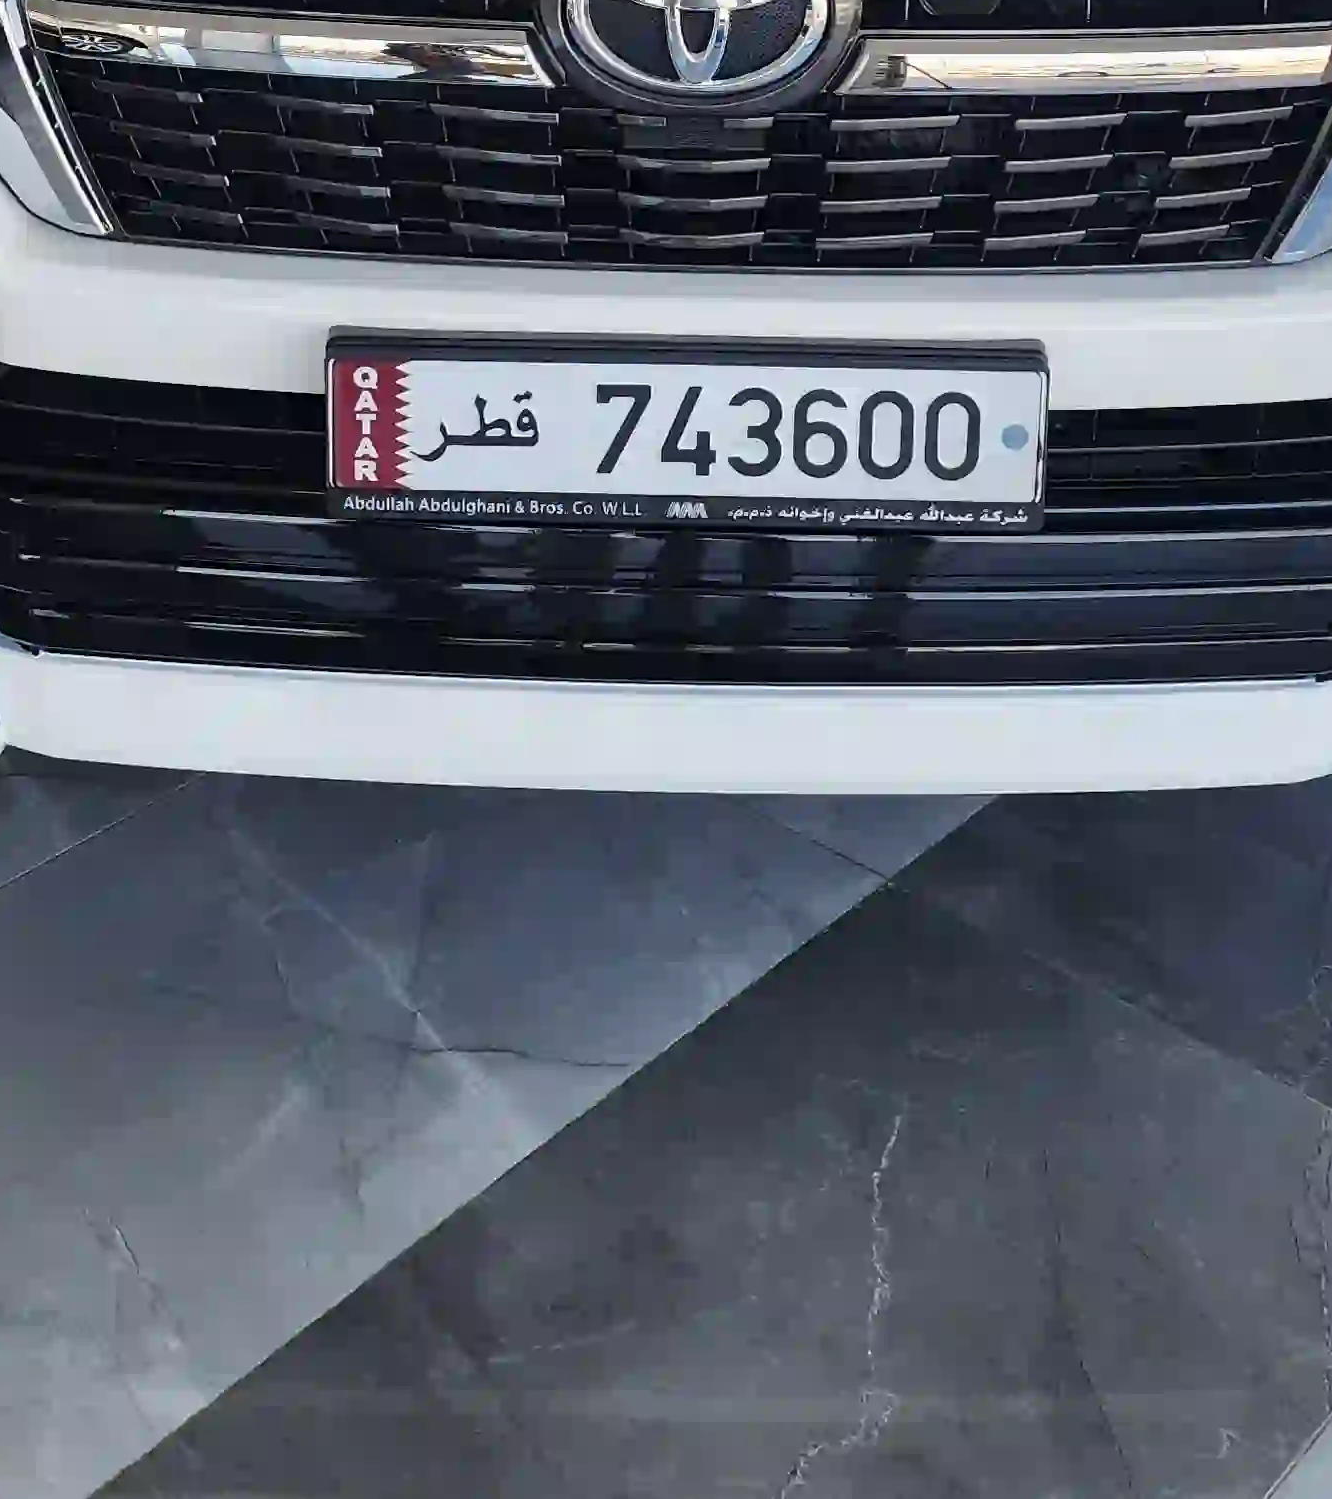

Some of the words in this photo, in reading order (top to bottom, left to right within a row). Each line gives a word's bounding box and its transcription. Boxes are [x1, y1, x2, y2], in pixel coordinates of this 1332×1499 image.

[352, 366, 380, 483] QATAR
[409, 390, 540, 462] قطر
[595, 383, 981, 481] 743600
[344, 496, 414, 513] Abdullah
[418, 497, 511, 516] Abdulghani
[514, 500, 526, 514] &
[529, 500, 567, 515] Bros.
[778, 506, 834, 524] وإخوانه
[839, 506, 914, 526] عبدالغني
[919, 505, 975, 524] عبدالله
[980, 506, 1028, 526] شركة
